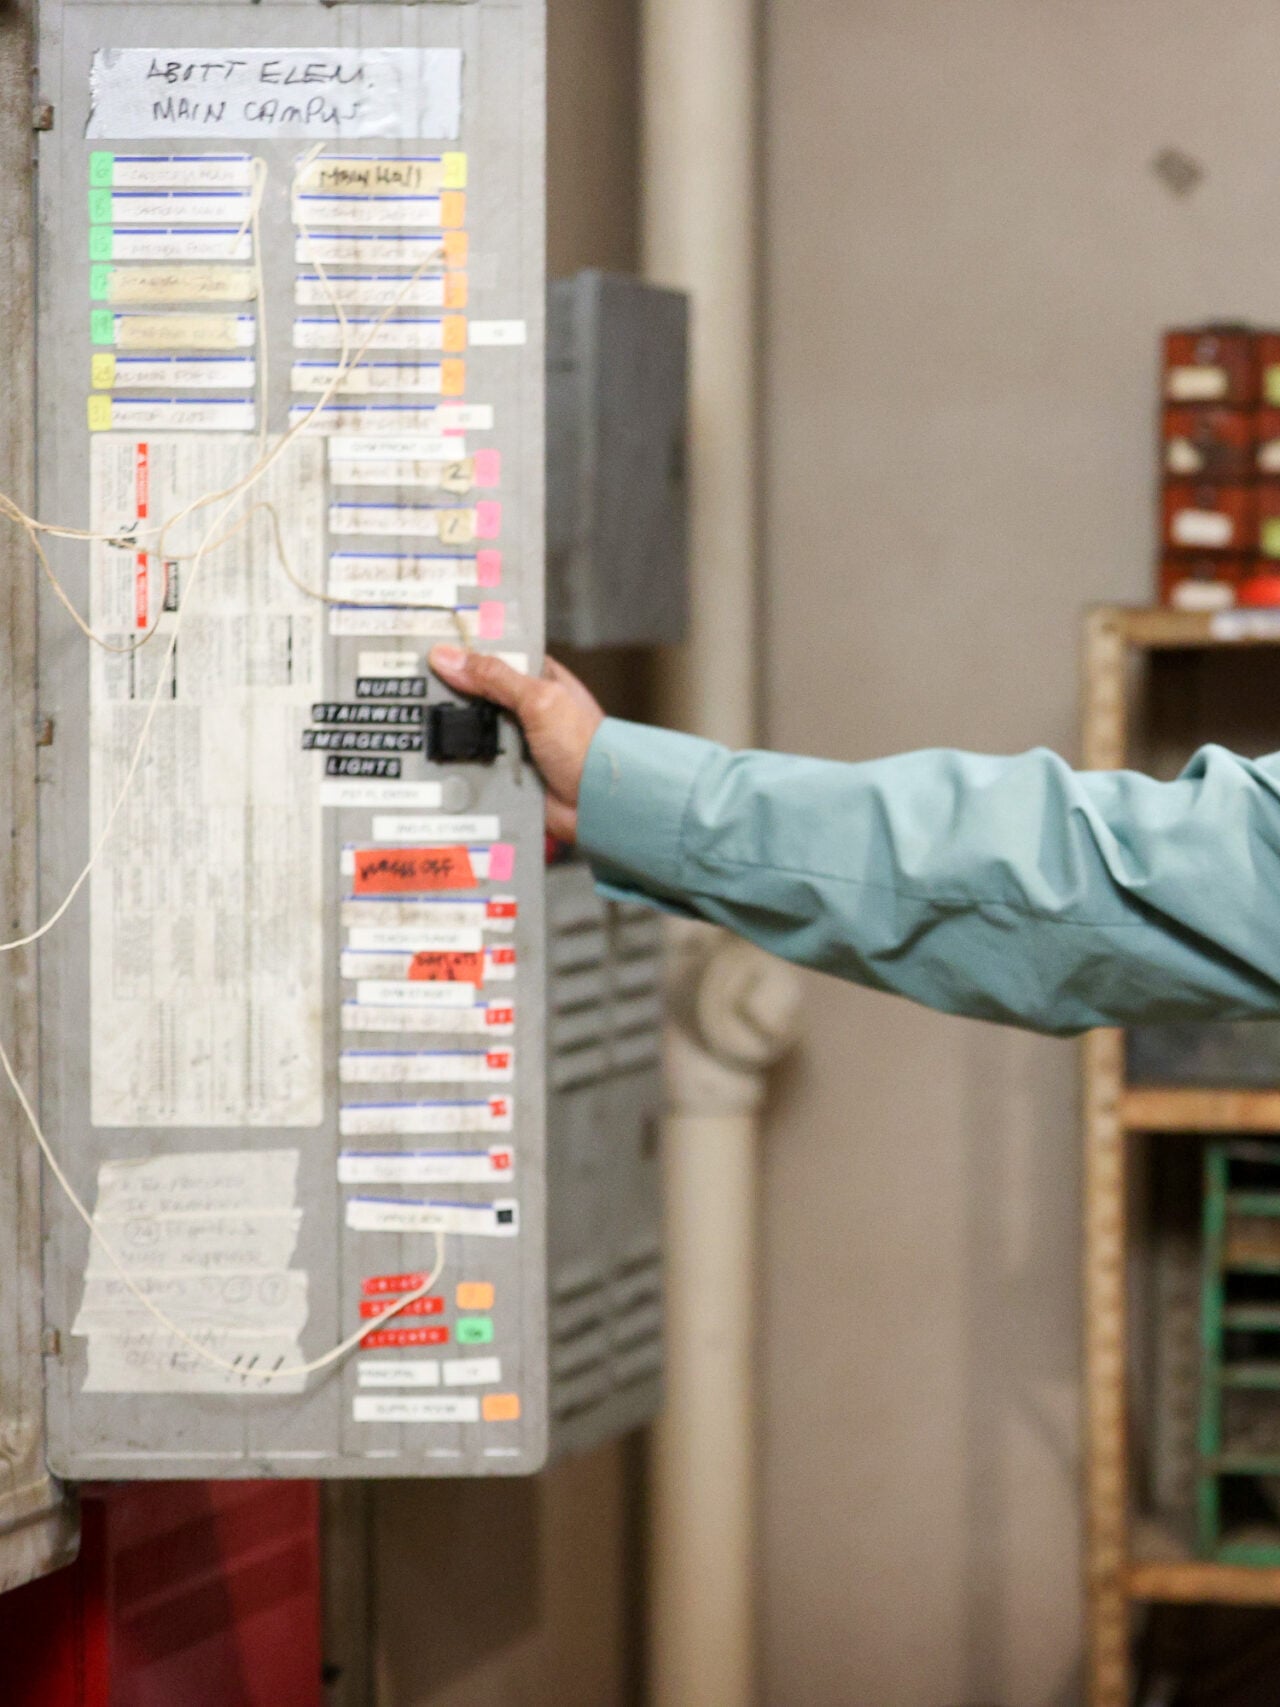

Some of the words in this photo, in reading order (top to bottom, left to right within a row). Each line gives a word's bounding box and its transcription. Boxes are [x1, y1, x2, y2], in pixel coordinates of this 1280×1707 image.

[152, 98, 225, 124] MAIN
[449, 463, 468, 481] 2
[358, 680, 425, 697] NURSE
[313, 705, 421, 722] STAIRWELL
[304, 732, 424, 749] EMERGENCY
[328, 758, 399, 777] LIGHTS
